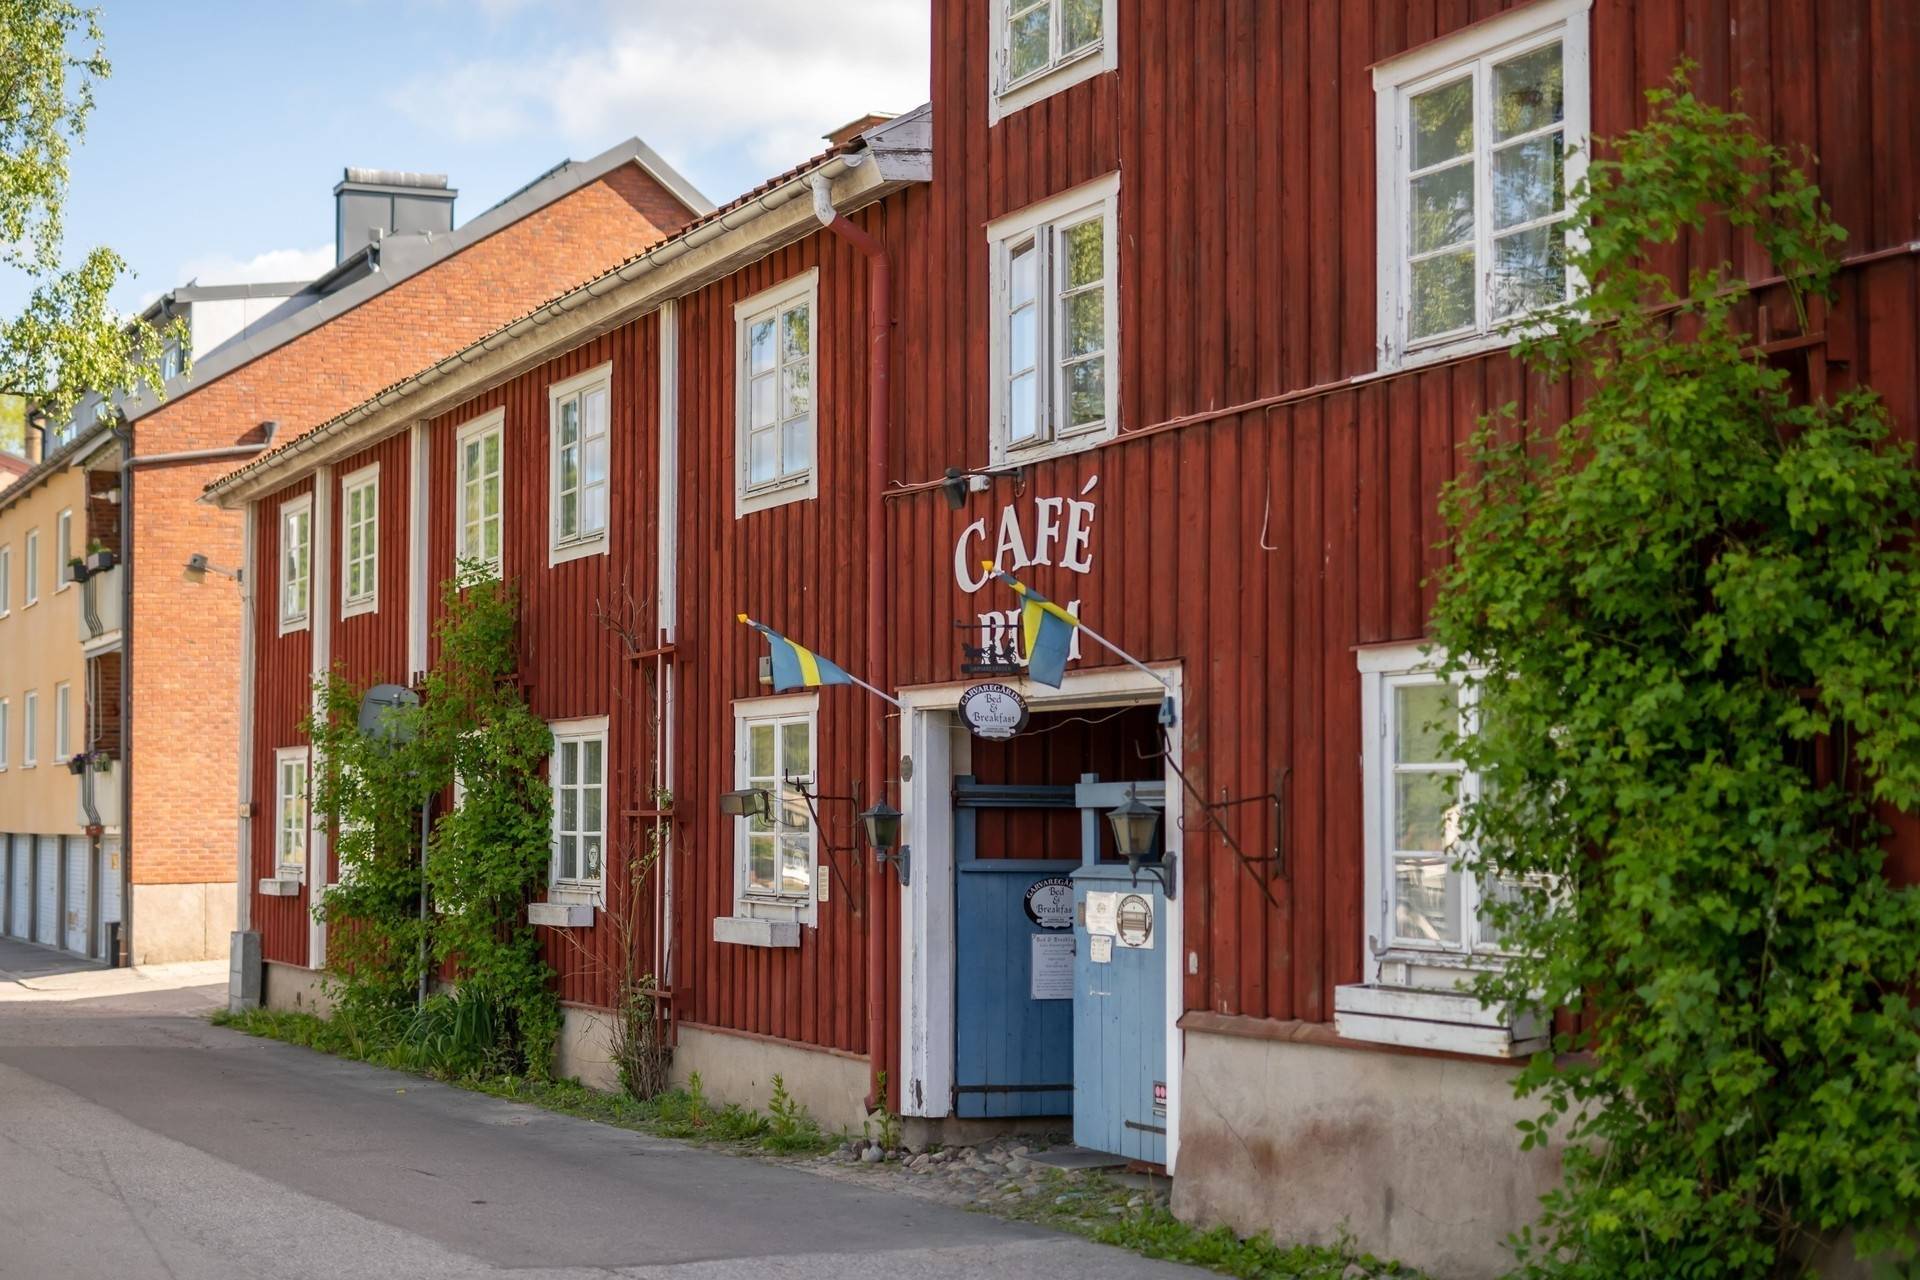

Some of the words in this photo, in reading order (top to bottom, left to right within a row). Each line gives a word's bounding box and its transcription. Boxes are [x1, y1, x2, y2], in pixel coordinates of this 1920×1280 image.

[954, 475, 1098, 593] CAFÉ
[985, 693, 1002, 704] Bed
[989, 702, 998, 713] &
[1158, 696, 1173, 728] 4
[973, 711, 1016, 724] Breakfast
[1049, 886, 1065, 896] Bed
[1052, 896, 1061, 905] &
